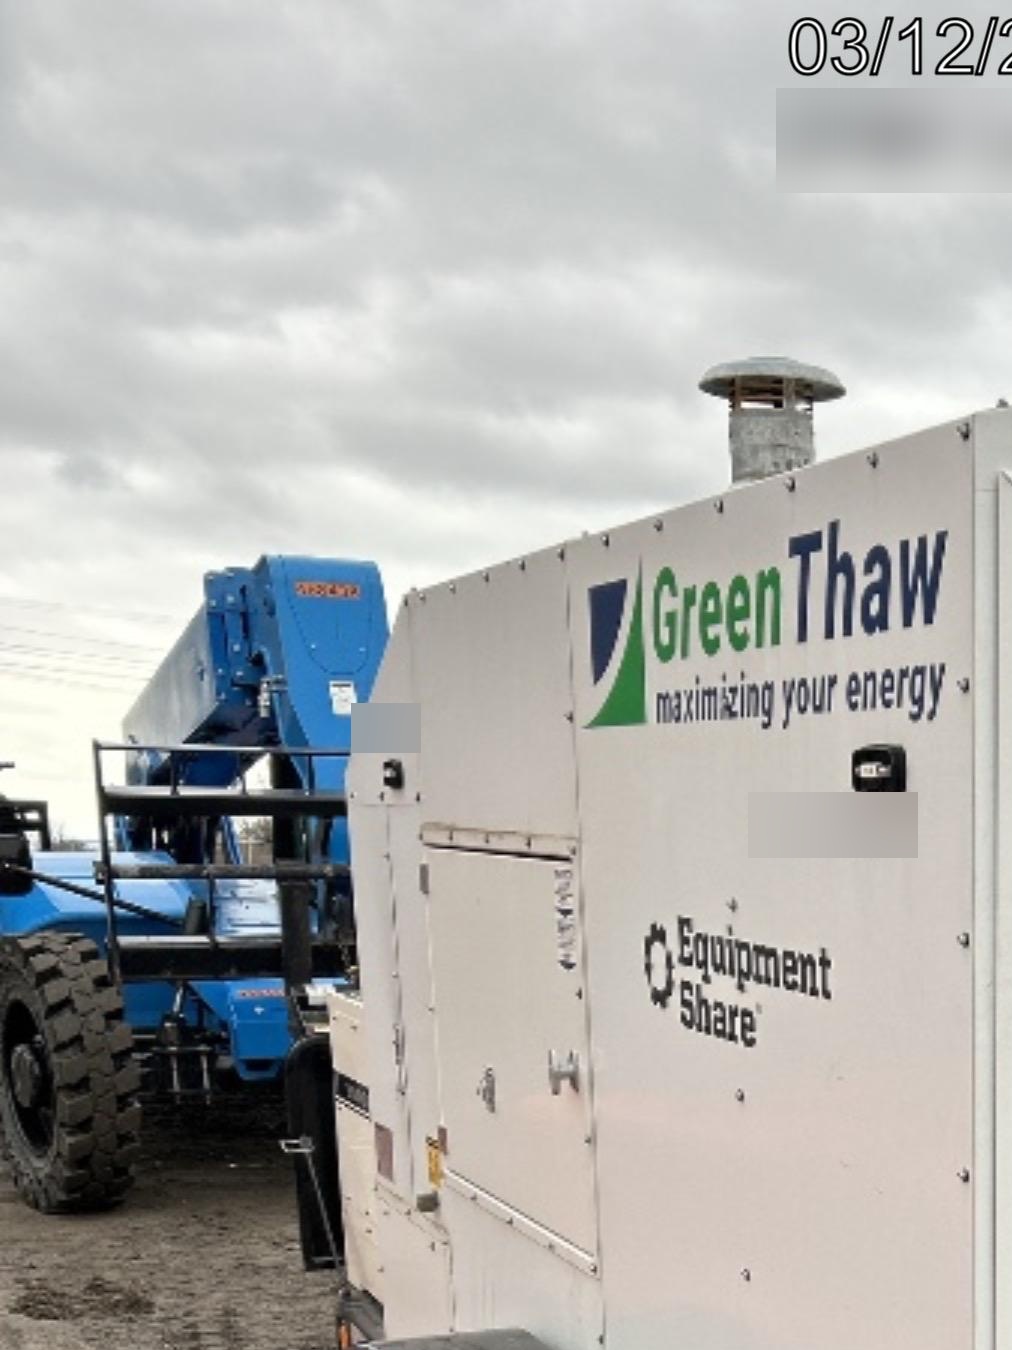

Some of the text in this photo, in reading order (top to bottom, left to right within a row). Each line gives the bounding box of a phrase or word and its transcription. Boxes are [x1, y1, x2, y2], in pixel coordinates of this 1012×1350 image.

[655, 662, 946, 730] maximizing your energy
[677, 915, 832, 1000] Equipment
[680, 979, 757, 1048] Share
